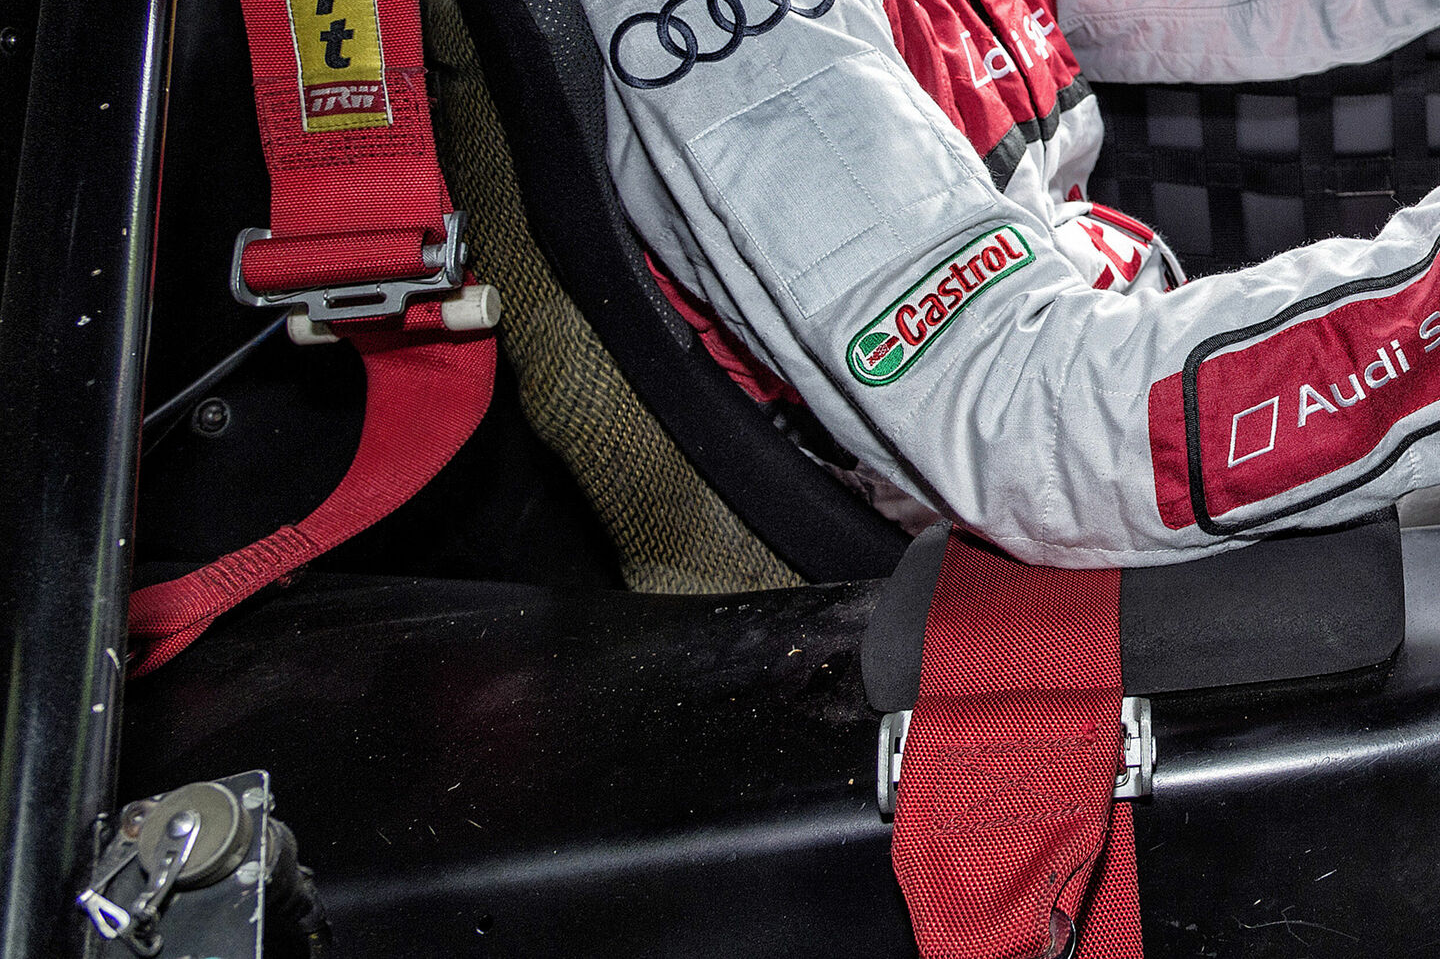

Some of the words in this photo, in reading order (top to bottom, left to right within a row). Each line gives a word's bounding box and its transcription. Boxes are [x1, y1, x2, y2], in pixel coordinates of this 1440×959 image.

[310, 85, 379, 112] TRW
[895, 231, 1025, 349] Castrol
[1296, 336, 1411, 428] Audi
